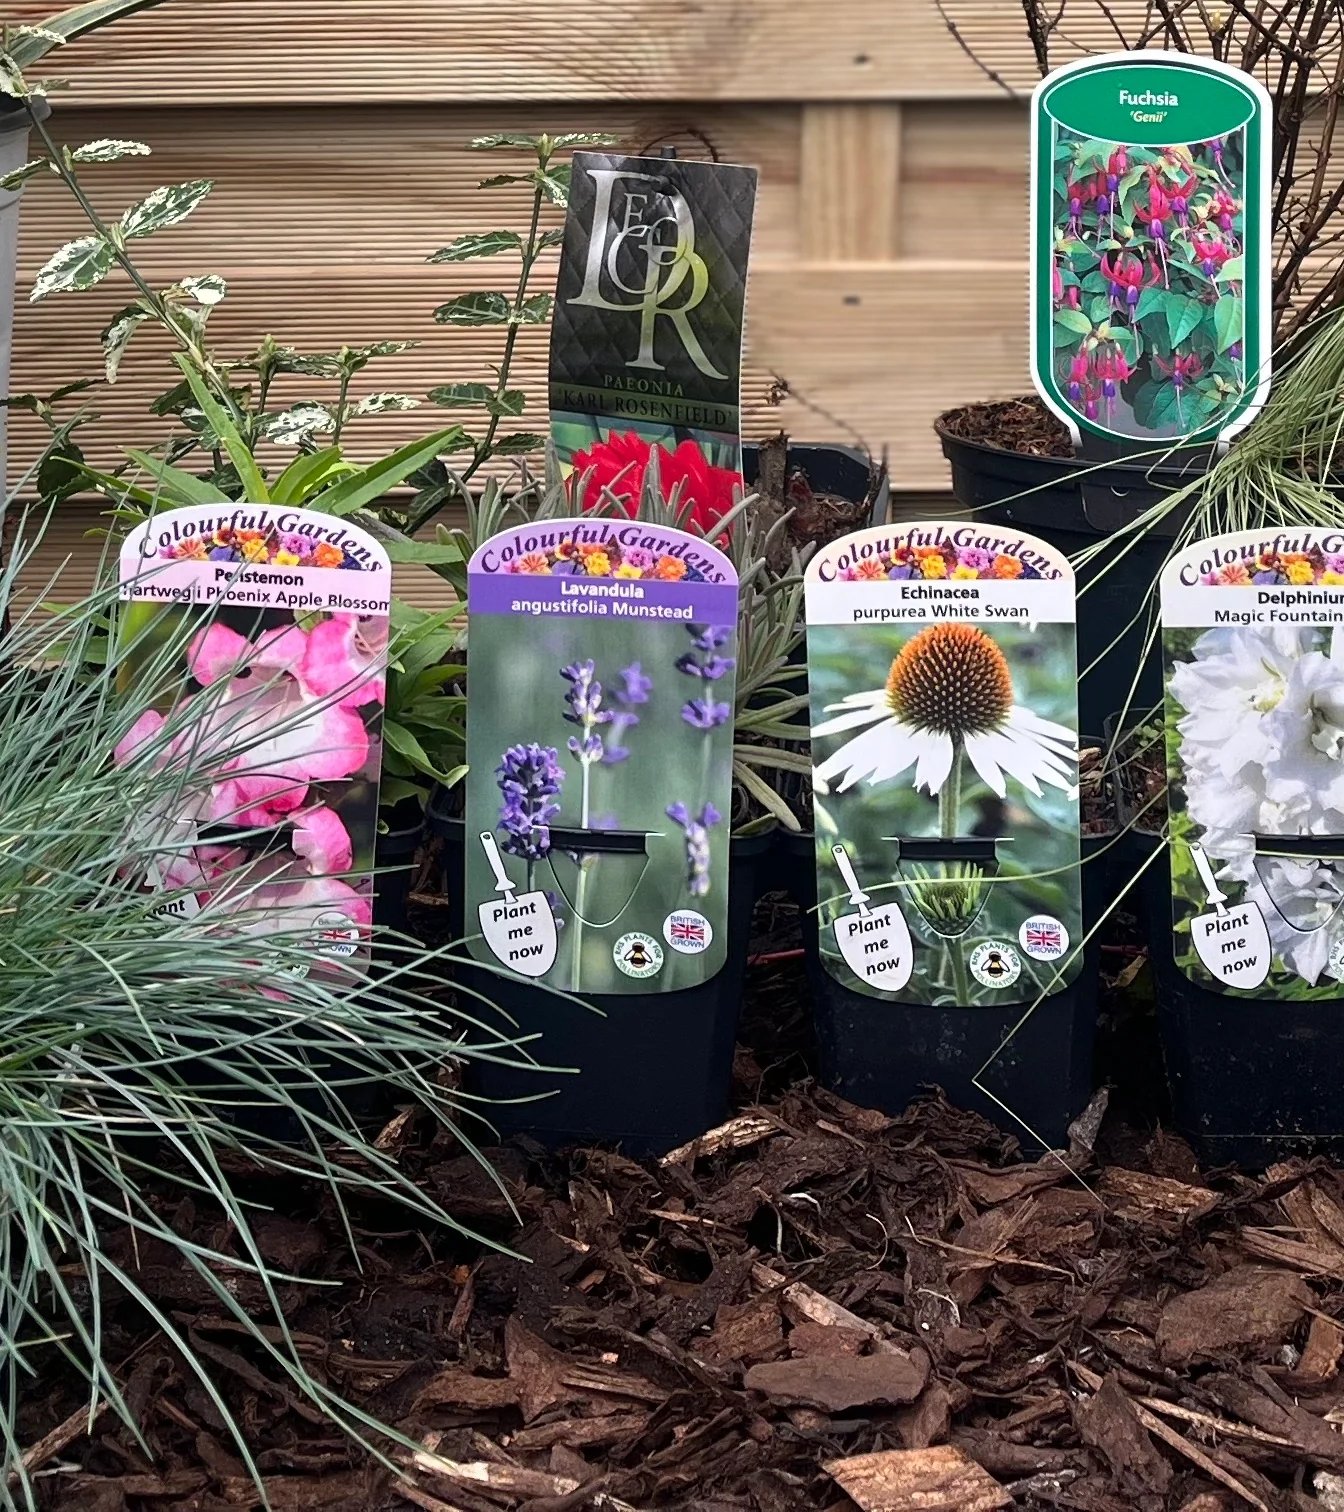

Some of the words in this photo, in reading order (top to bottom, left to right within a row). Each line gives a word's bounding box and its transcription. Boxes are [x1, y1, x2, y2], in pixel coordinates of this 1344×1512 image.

[1119, 89, 1179, 106] Fuchsia
[603, 373, 684, 397] PAEONIA
[615, 396, 732, 426] ROSENFIELD'
[139, 510, 268, 559] Colourful
[277, 513, 384, 572] Gardens
[481, 524, 608, 573] Colourful
[618, 526, 727, 584] Gardens
[818, 527, 948, 583] Colourful
[953, 528, 1064, 581] Gardens
[1179, 533, 1314, 587] Colourful
[123, 584, 201, 602] hartwegi
[206, 586, 270, 603] Phoenix
[276, 591, 323, 608] Apple
[561, 581, 645, 599] Lavandula
[901, 586, 980, 600] Echinacea
[511, 598, 607, 616] angustifolia
[612, 602, 693, 620] Munstead
[853, 605, 926, 621] purpurea
[931, 604, 980, 618] White
[984, 604, 1029, 618] Swan
[1214, 609, 1265, 626] Magic
[1269, 609, 1343, 623] Fountain
[142, 899, 186, 919] ant
[492, 901, 537, 922] Plant
[670, 915, 705, 926] BRITISH
[848, 914, 892, 937] Plant
[1025, 921, 1061, 931] BRITISH
[1205, 913, 1250, 937] Plant
[508, 925, 533, 940] me
[623, 933, 654, 945] PLANTS
[670, 937, 705, 949] GROWN
[864, 939, 889, 955] me
[979, 942, 1010, 953] PLANTS
[1026, 945, 1062, 955] GROWN
[1221, 938, 1247, 954] me
[509, 944, 544, 961] now
[866, 957, 900, 976] now
[1223, 954, 1258, 976] now
